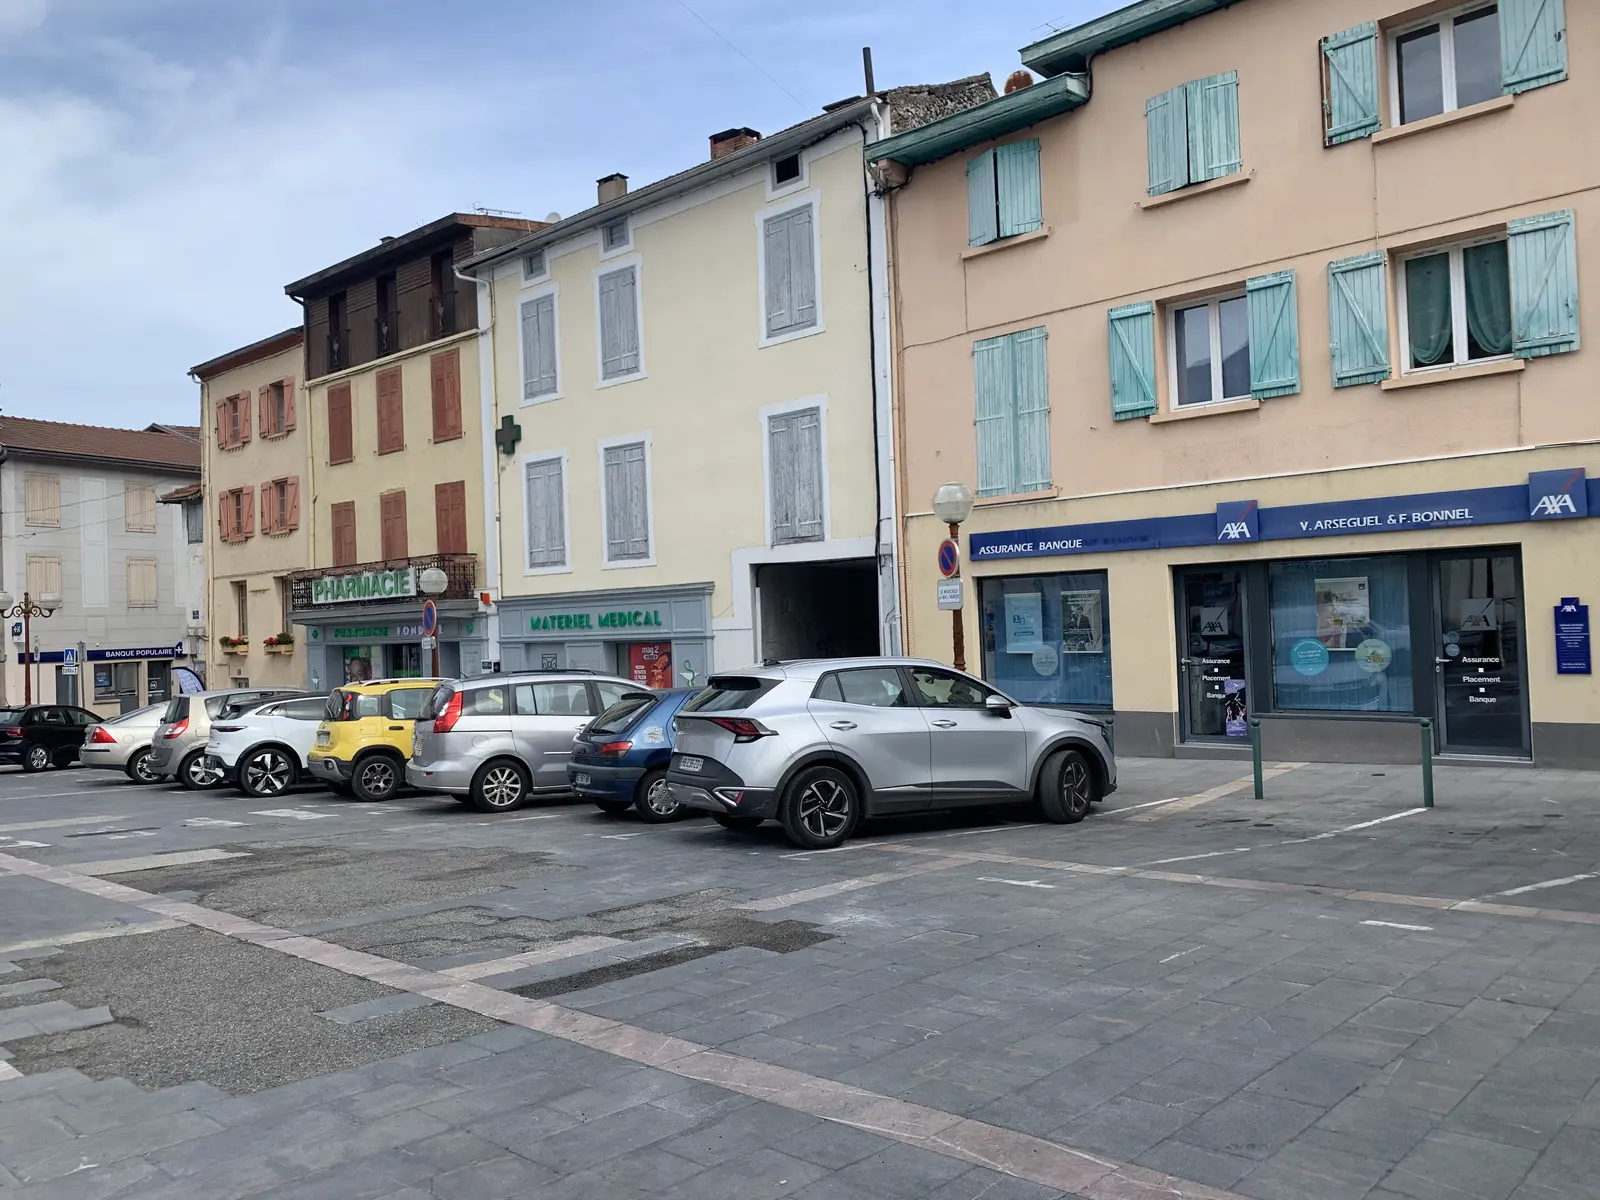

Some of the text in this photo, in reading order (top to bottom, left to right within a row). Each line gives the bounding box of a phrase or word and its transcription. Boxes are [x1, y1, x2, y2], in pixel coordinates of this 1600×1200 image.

[1530, 494, 1577, 516] AXA
[1314, 515, 1382, 530] ARSEGUEL
[1412, 508, 1473, 523] BONNEL
[1218, 521, 1251, 540] AXA
[978, 542, 1033, 555] ASSURANCE
[1039, 539, 1082, 551] BANQUE
[313, 570, 411, 601] PHARMACIE
[530, 610, 663, 631] MATERIEL MEDICAL
[334, 627, 389, 638] PHARMACIE
[105, 648, 173, 658] BANQUE POPULAIRE
[654, 645, 659, 654] 2
[1462, 675, 1501, 683] Placement
[1469, 696, 1497, 704] Banque
